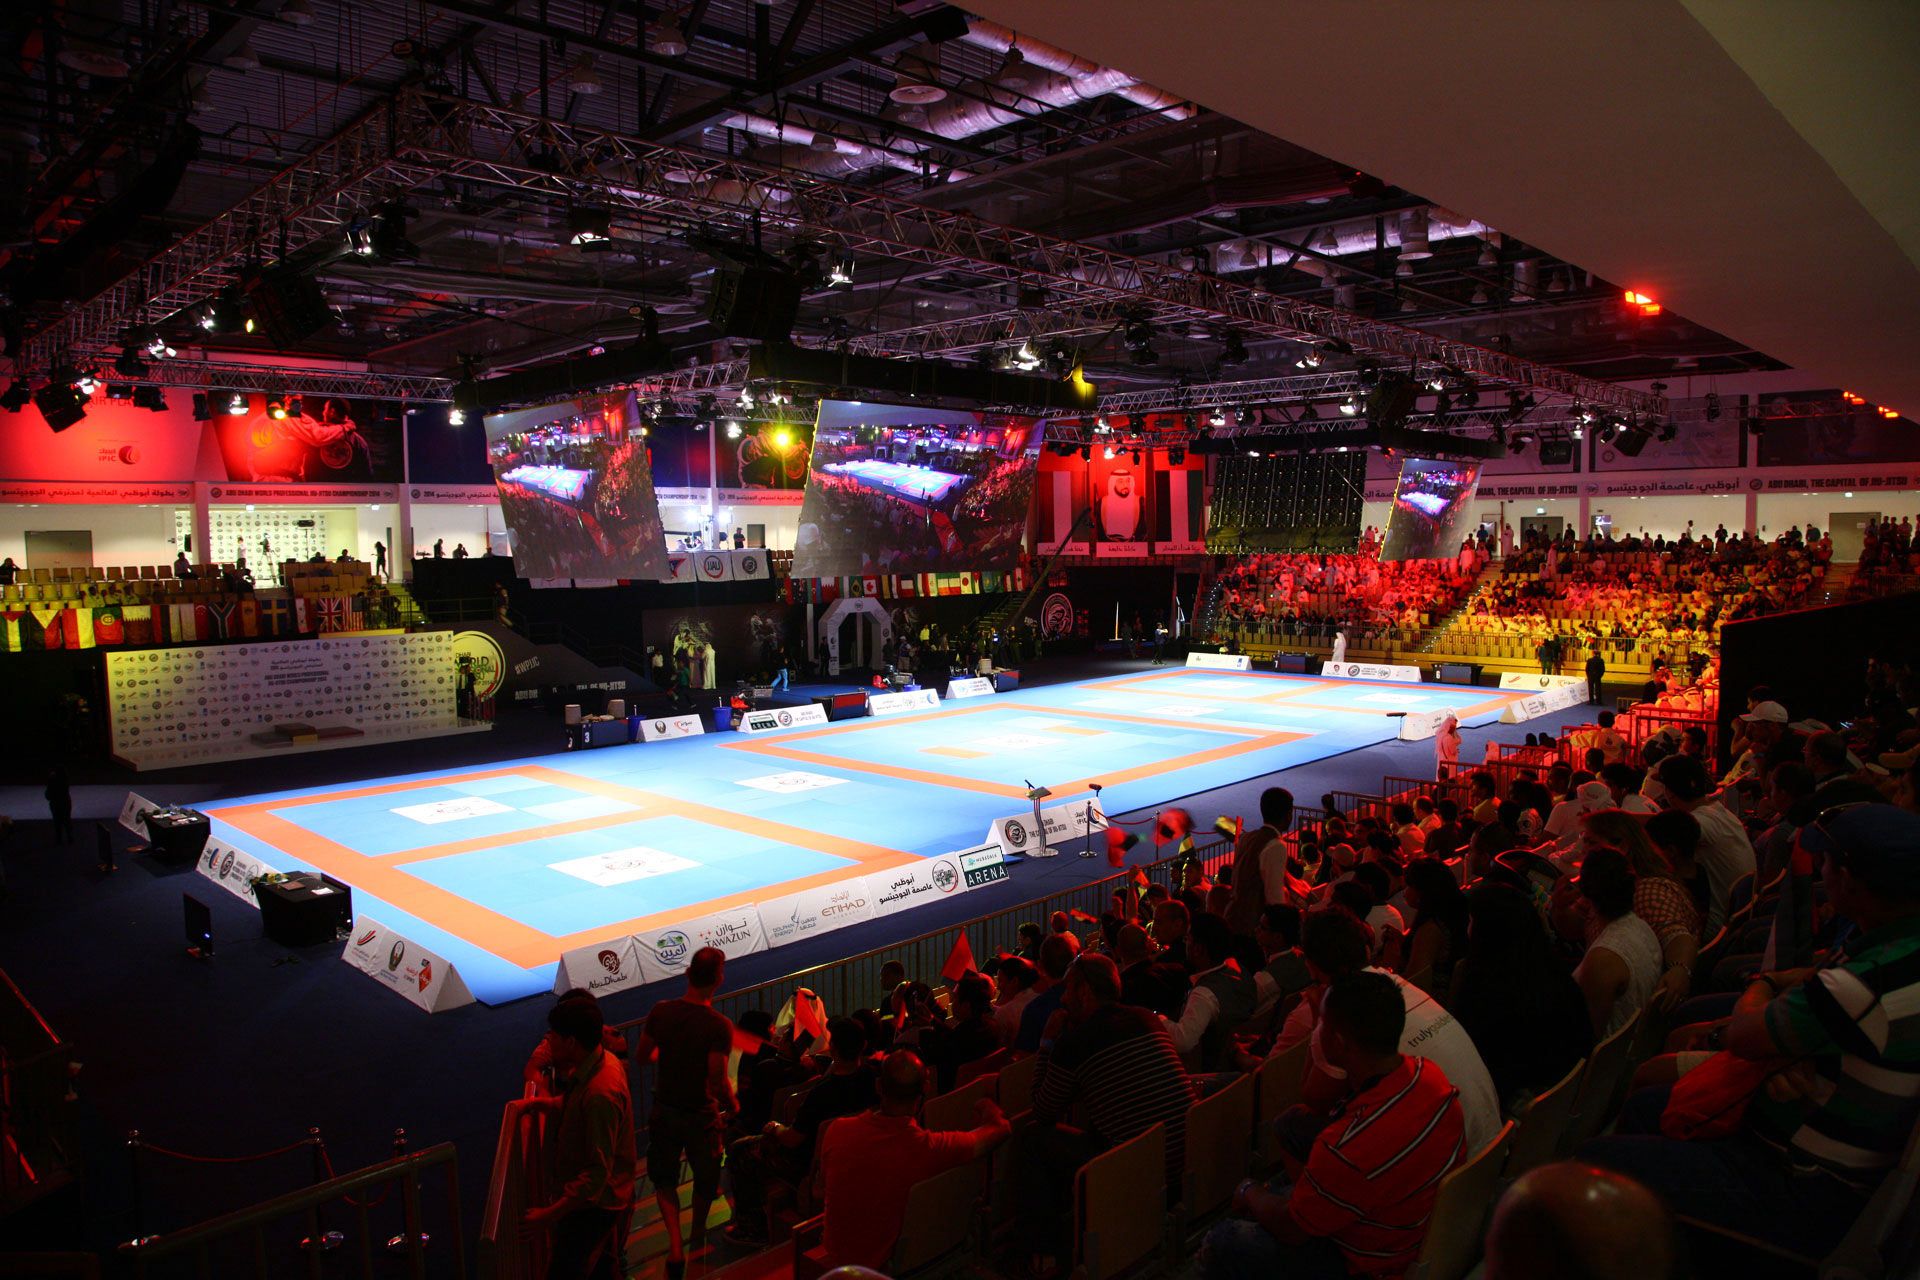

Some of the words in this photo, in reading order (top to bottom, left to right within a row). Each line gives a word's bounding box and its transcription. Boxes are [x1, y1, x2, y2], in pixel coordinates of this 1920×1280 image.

[1660, 482, 1694, 492] عاصمة
[1768, 479, 1783, 489] ABU
[1811, 478, 1825, 488] THE
[1825, 478, 1856, 488] CAPITAL
[1860, 477, 1870, 487] OF
[1870, 476, 1908, 487] JIU-JITSU
[1498, 486, 1510, 496] THE
[1510, 485, 1536, 496] CAPITAL
[1538, 485, 1546, 495] OF
[1547, 484, 1578, 495] JIU-JITSU
[584, 731, 590, 743] 3
[967, 864, 1007, 886] ARENA
[890, 872, 916, 892] أبوظبي
[911, 882, 933, 894] عاصمة
[878, 888, 911, 905] الجوجيتسو
[821, 898, 866, 918] ETIHAD
[772, 922, 795, 933] DOLPHIN
[774, 929, 794, 938] ENERGY
[704, 929, 751, 948] TAWAZUN
[660, 943, 687, 961] العين
